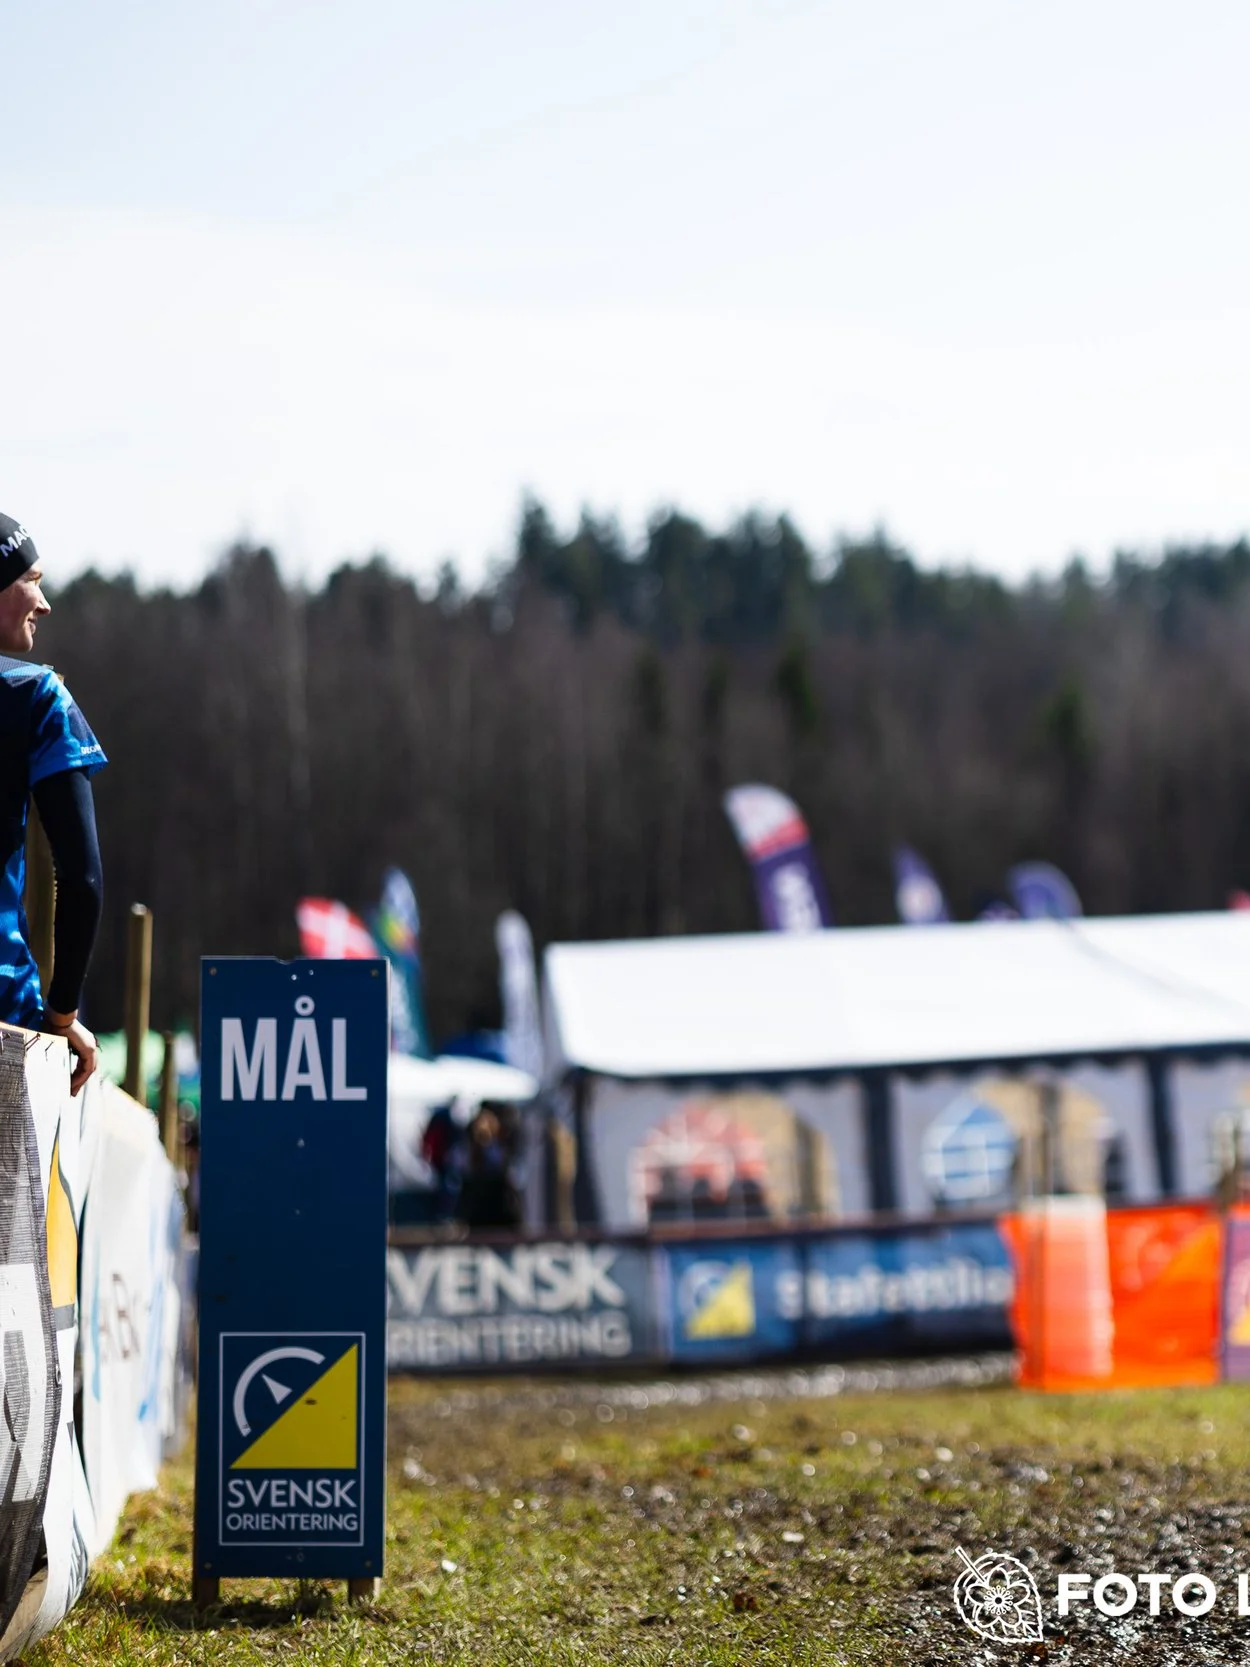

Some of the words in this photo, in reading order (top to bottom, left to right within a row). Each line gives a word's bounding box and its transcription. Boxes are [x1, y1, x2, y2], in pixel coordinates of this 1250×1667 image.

[220, 996, 368, 1101] MÅL
[386, 1243, 626, 1315] VENSK
[386, 1311, 633, 1367] RIENTERING
[227, 1478, 357, 1508] SVENSK
[225, 1512, 359, 1532] ORIENTERING
